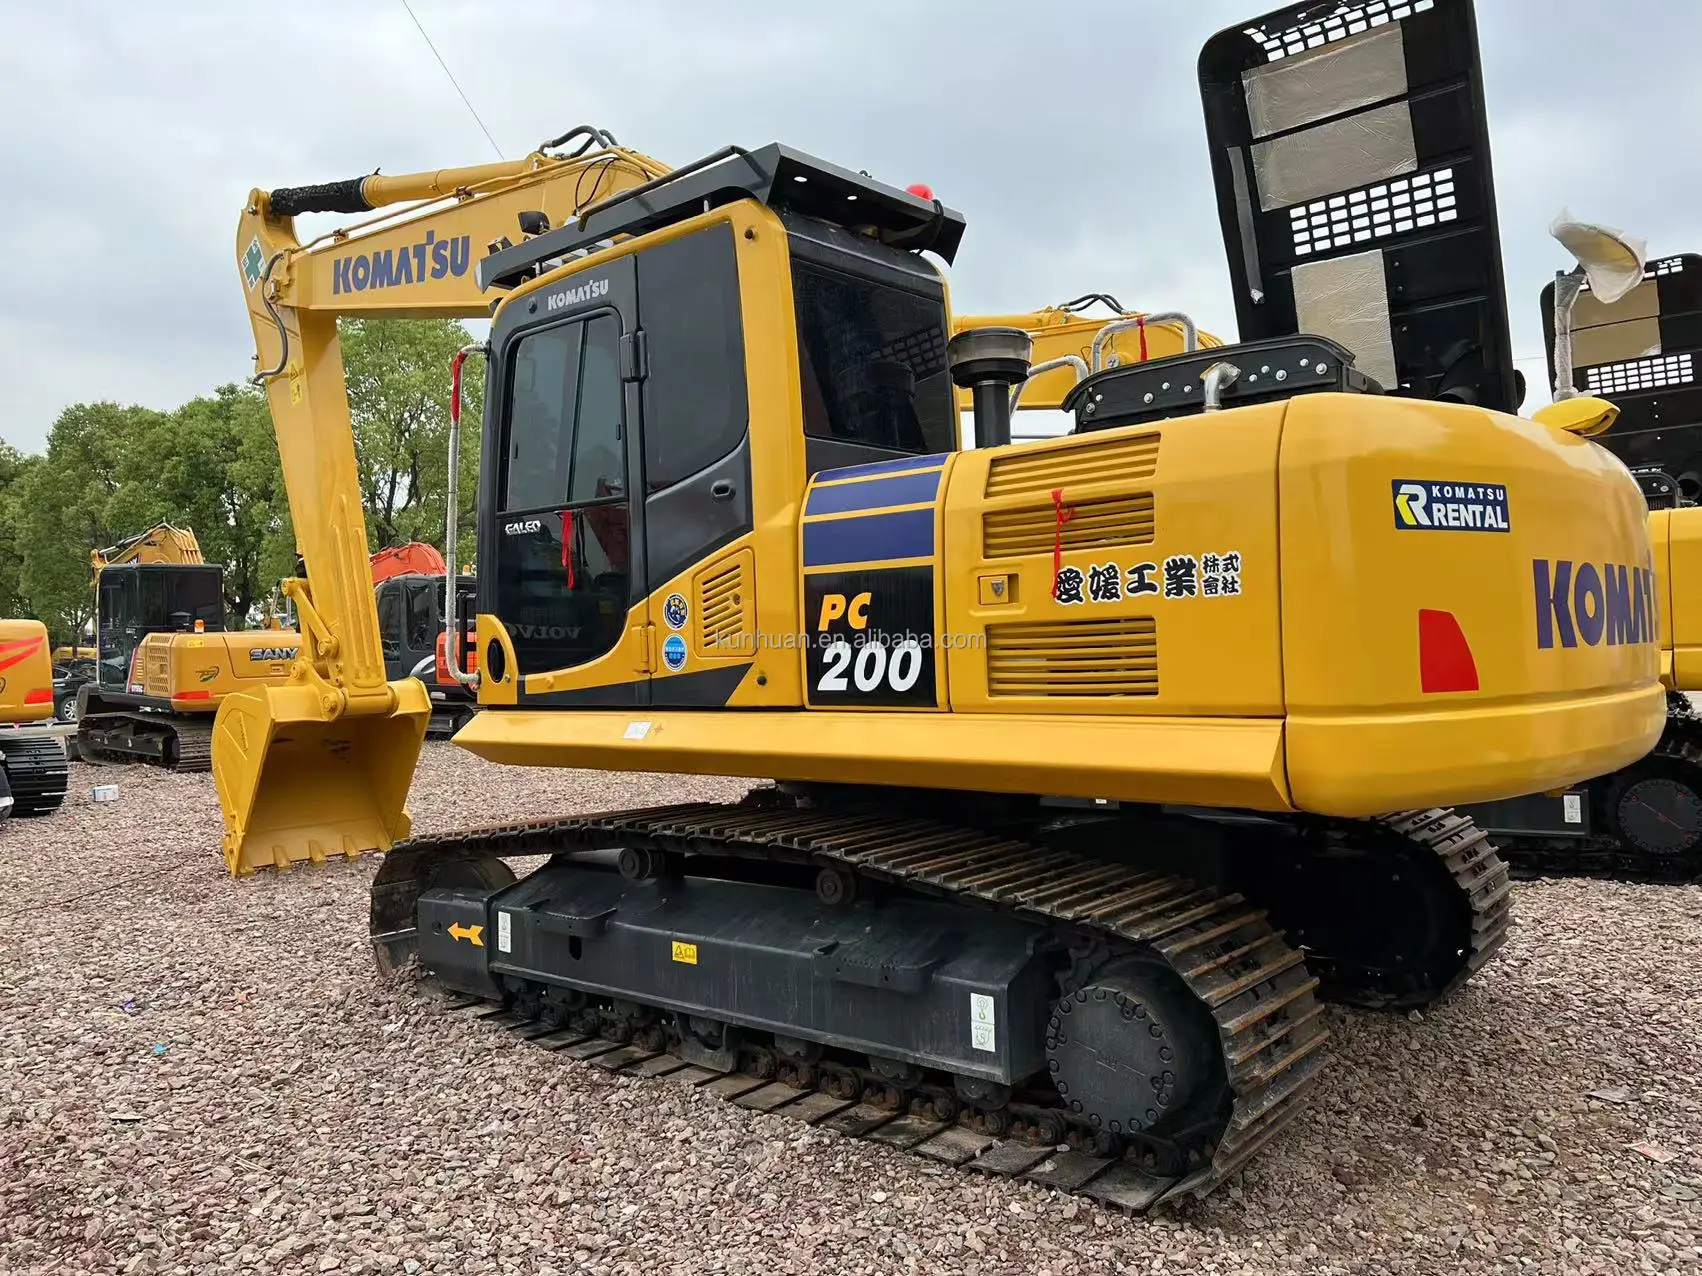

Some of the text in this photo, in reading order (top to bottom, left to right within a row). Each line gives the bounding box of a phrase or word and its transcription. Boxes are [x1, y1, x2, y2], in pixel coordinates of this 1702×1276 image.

[332, 229, 471, 295] KOMATSU
[547, 278, 609, 311] KOMATSU
[1431, 485, 1504, 501] KOMATSU
[504, 520, 541, 535] GALEO
[1431, 502, 1508, 528] RENTAL
[817, 592, 873, 631] PC
[248, 648, 299, 661] SANY
[816, 639, 924, 693] 200
